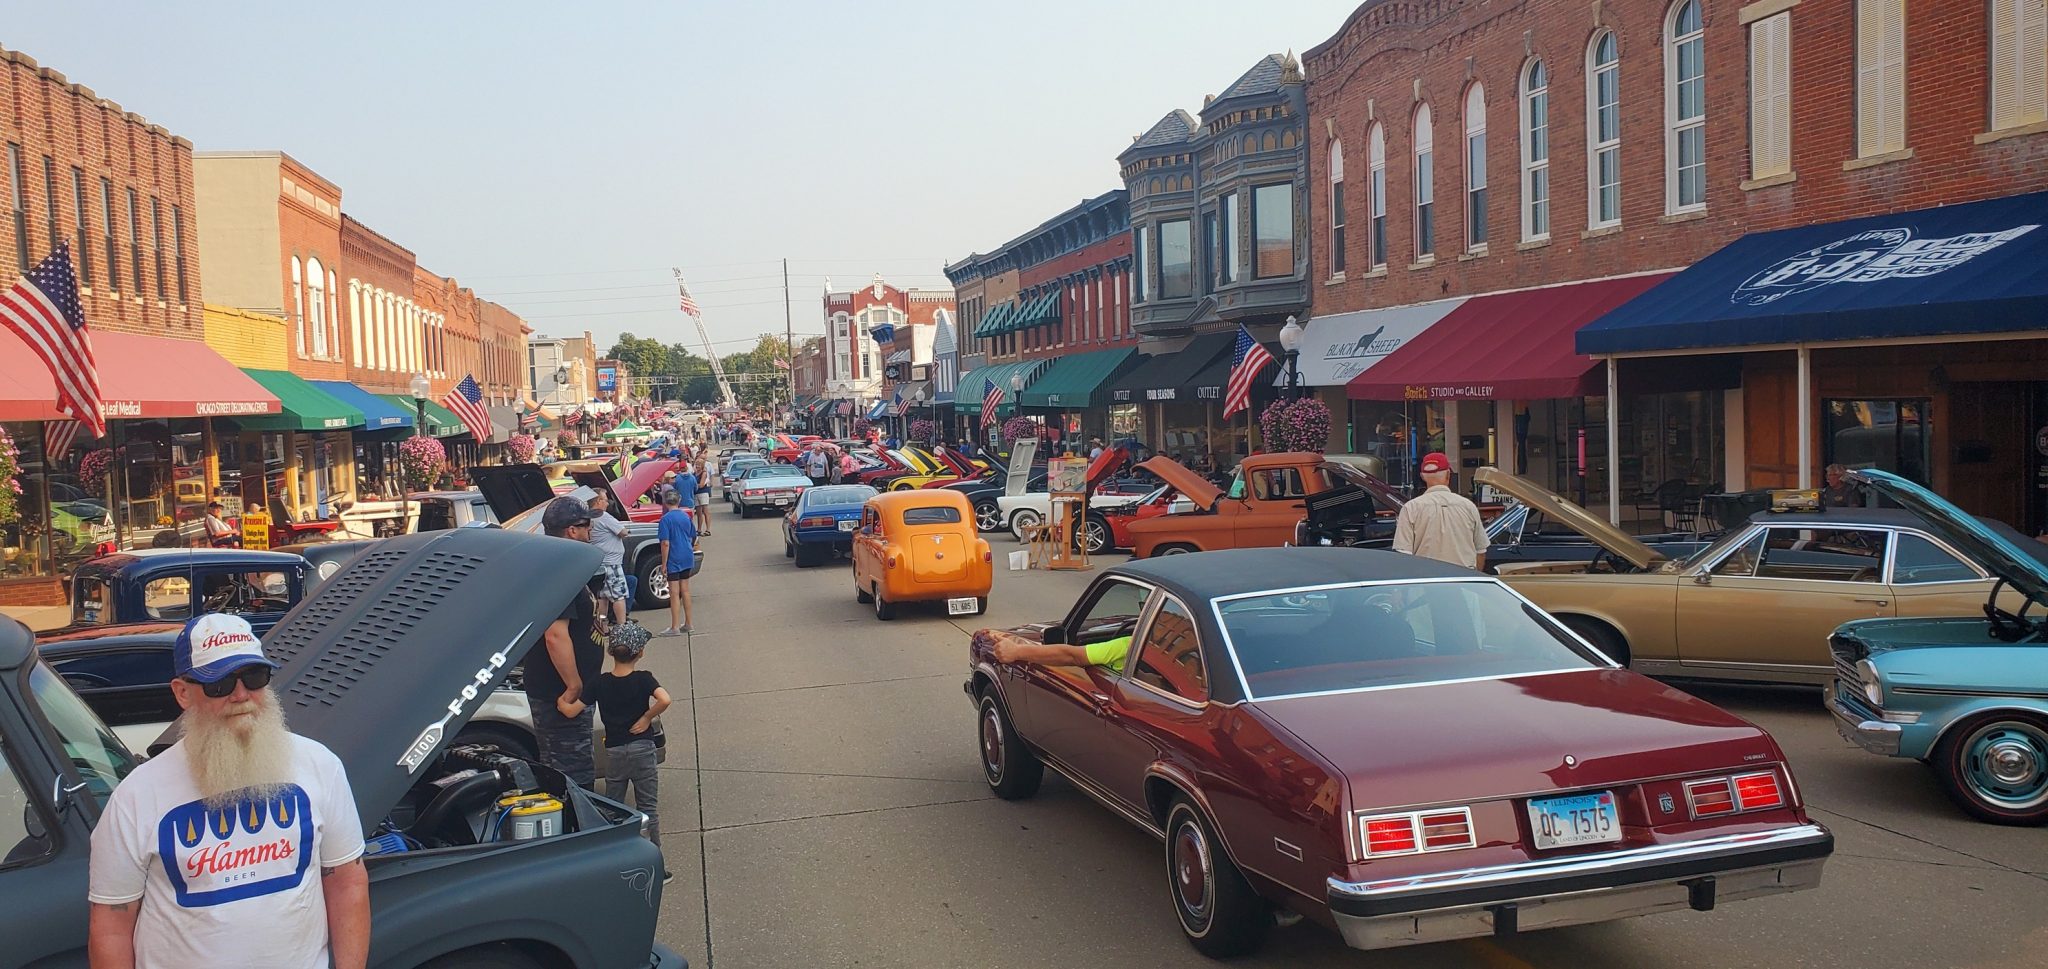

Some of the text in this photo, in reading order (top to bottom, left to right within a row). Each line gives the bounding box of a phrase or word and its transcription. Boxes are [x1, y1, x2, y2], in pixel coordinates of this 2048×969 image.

[1749, 250, 1878, 288] B&B
[1326, 338, 1401, 356] BLACK SHEEP
[1113, 390, 1130, 401] OUTLET
[1197, 386, 1220, 399] OUTLET
[1404, 385, 1428, 399] Smith
[1430, 387, 1455, 397] STUDIO
[1464, 386, 1494, 397] GALLERY
[105, 401, 119, 416] Leaf
[119, 401, 141, 416] Medical
[1492, 496, 1513, 504] TRAINS
[447, 652, 507, 716] FORD
[1551, 796, 1592, 807] ILLINOIS
[1540, 807, 1610, 837] QC 7575
[187, 838, 295, 878] Hamm's
[224, 871, 256, 883] BEER
